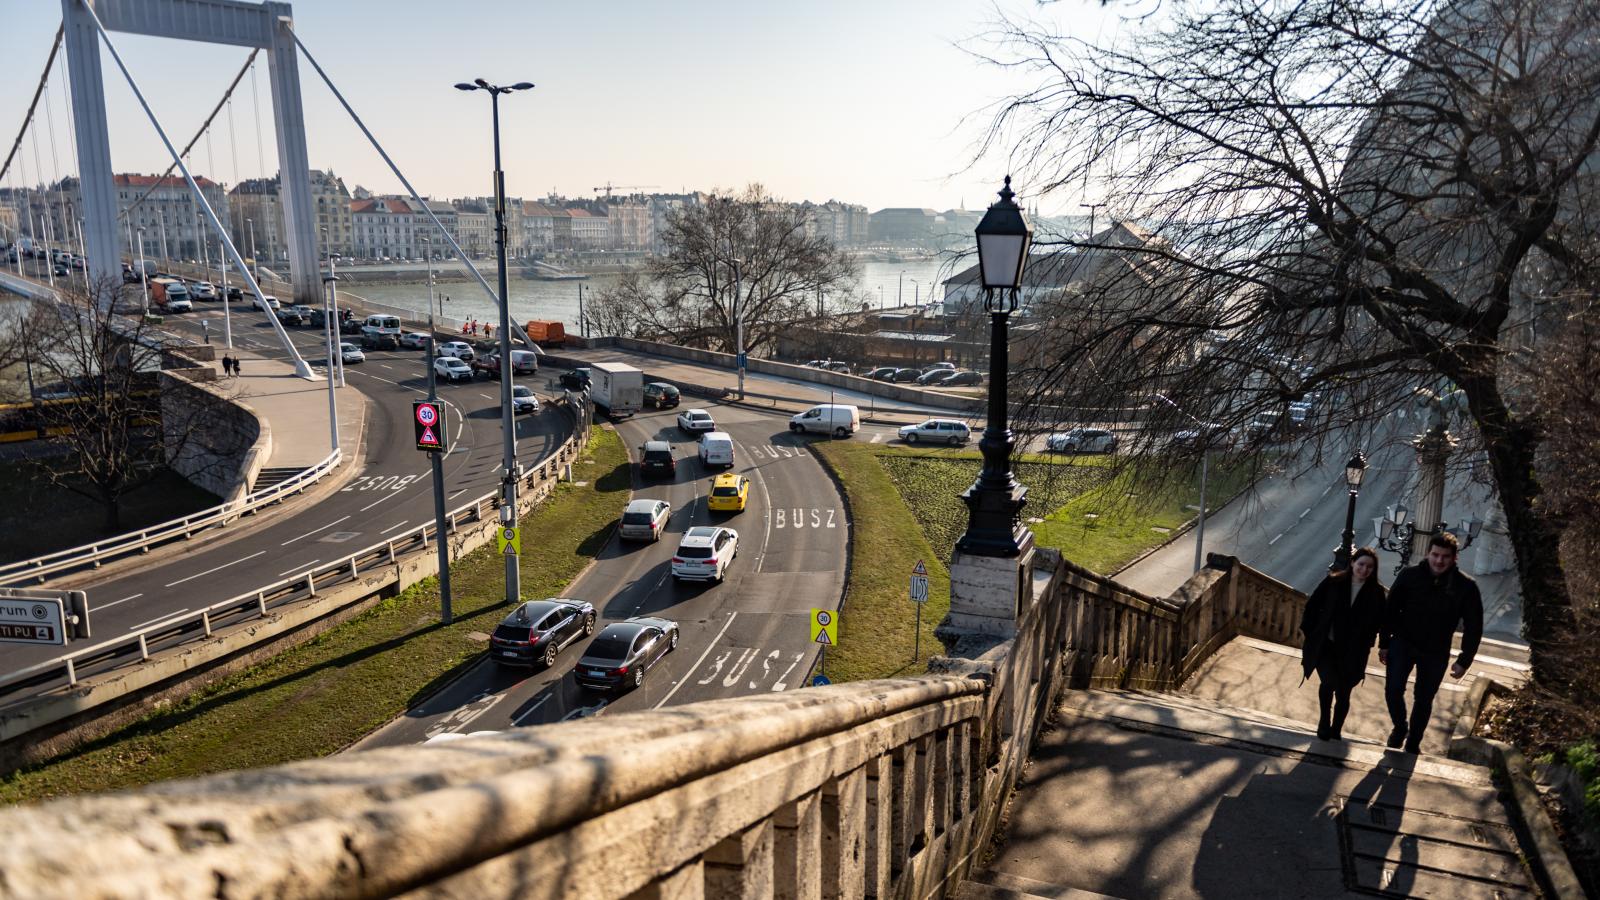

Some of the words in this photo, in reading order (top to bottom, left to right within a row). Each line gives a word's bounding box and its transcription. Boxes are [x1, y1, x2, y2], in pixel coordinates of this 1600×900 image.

[421, 410, 433, 420] 30
[341, 474, 418, 492] BUSZ
[776, 508, 836, 529] BUSZ
[819, 615, 828, 623] 30
